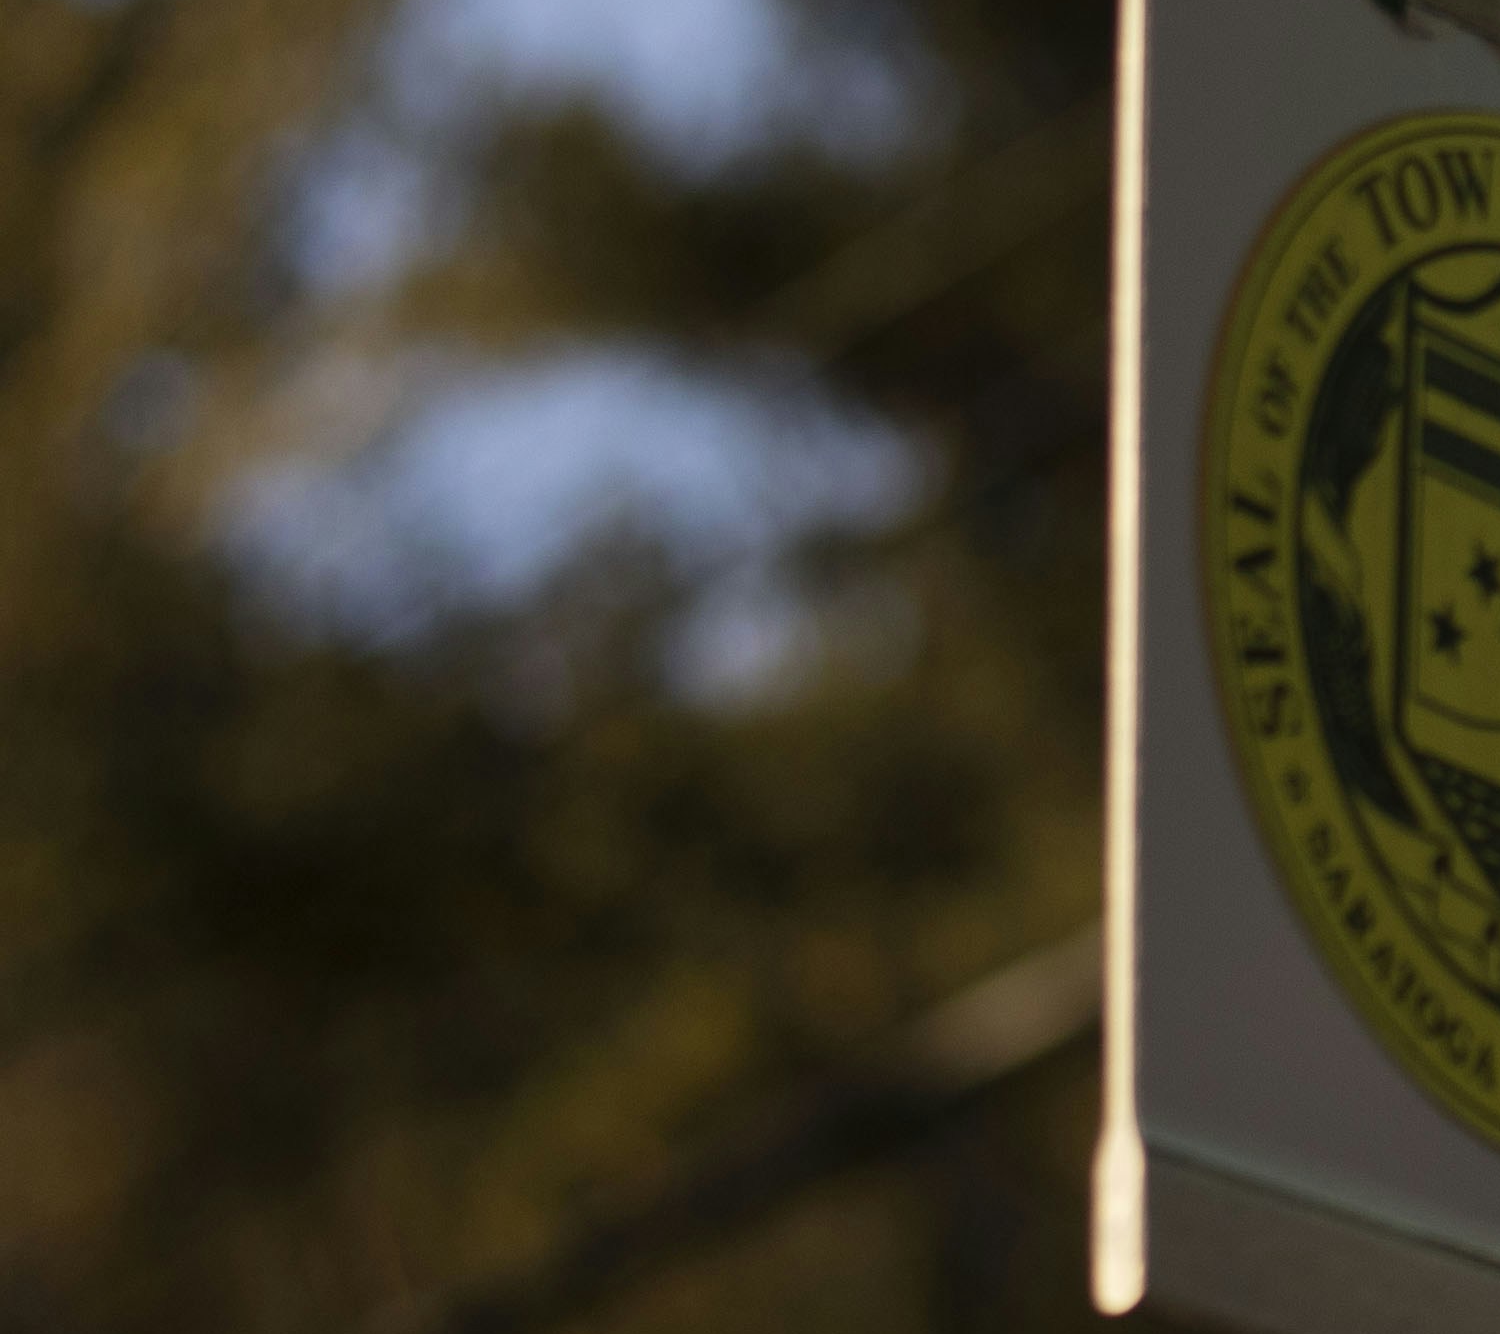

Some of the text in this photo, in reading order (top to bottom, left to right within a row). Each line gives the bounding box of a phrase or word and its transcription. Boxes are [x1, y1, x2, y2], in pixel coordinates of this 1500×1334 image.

[1285, 234, 1359, 346] THE
[1254, 352, 1300, 439] OF
[1231, 468, 1304, 740] SEAL
